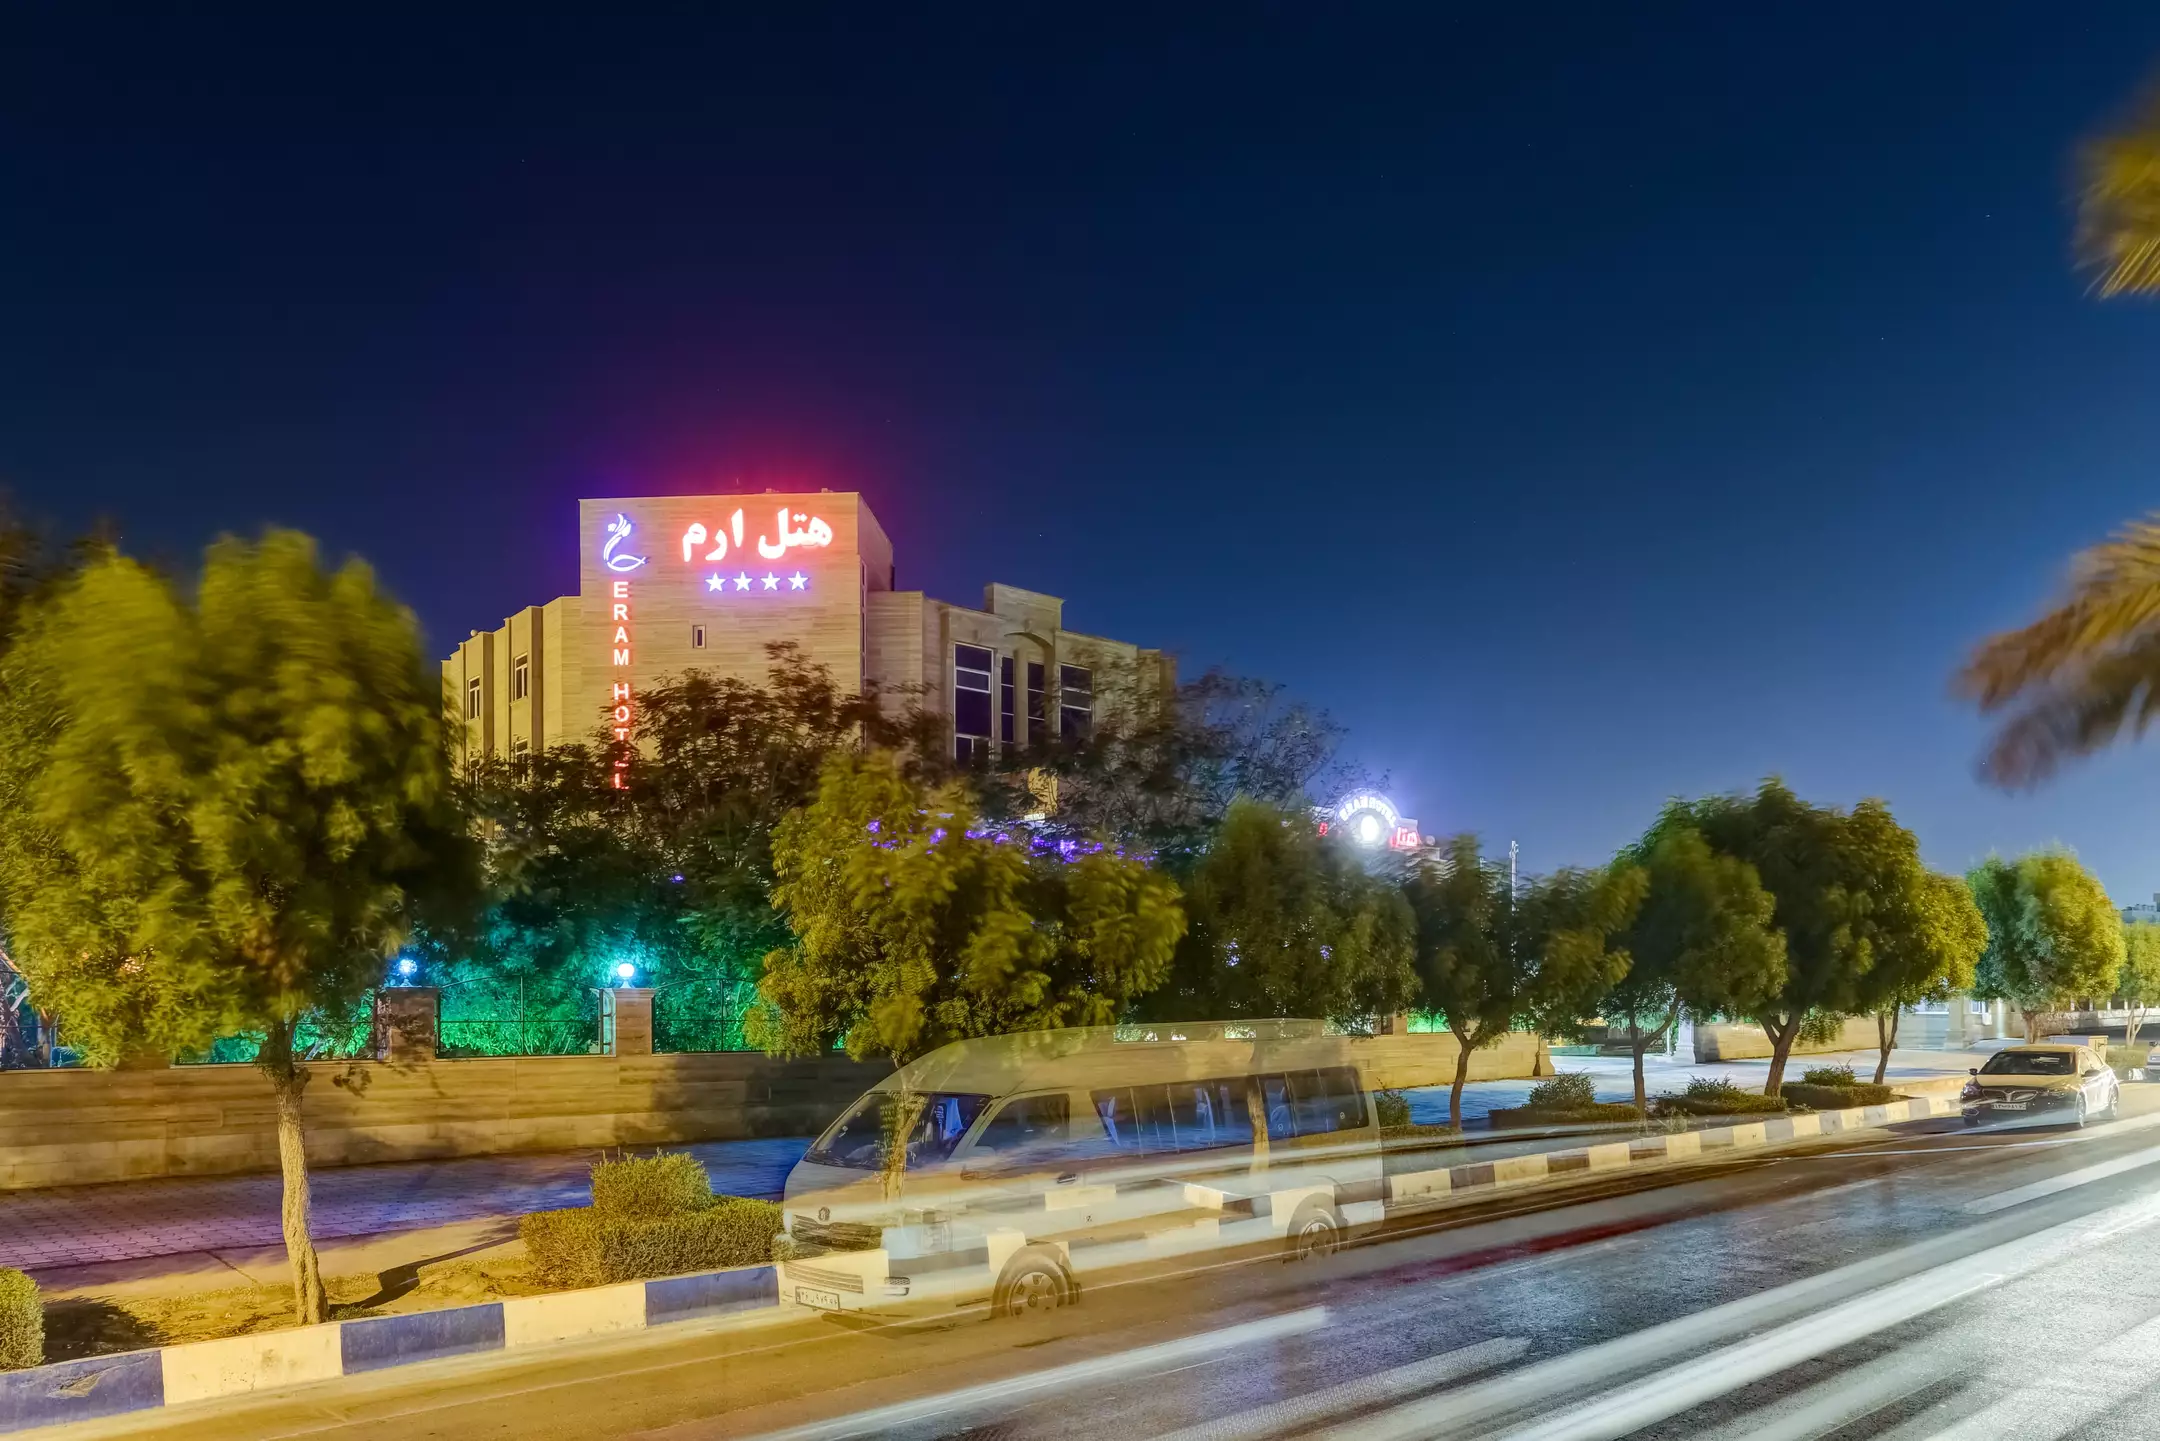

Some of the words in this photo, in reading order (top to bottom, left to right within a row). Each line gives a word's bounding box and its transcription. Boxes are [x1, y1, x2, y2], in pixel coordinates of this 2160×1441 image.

[682, 507, 744, 562] ارم
[758, 507, 833, 560] هتل
[613, 580, 630, 667] ERAM
